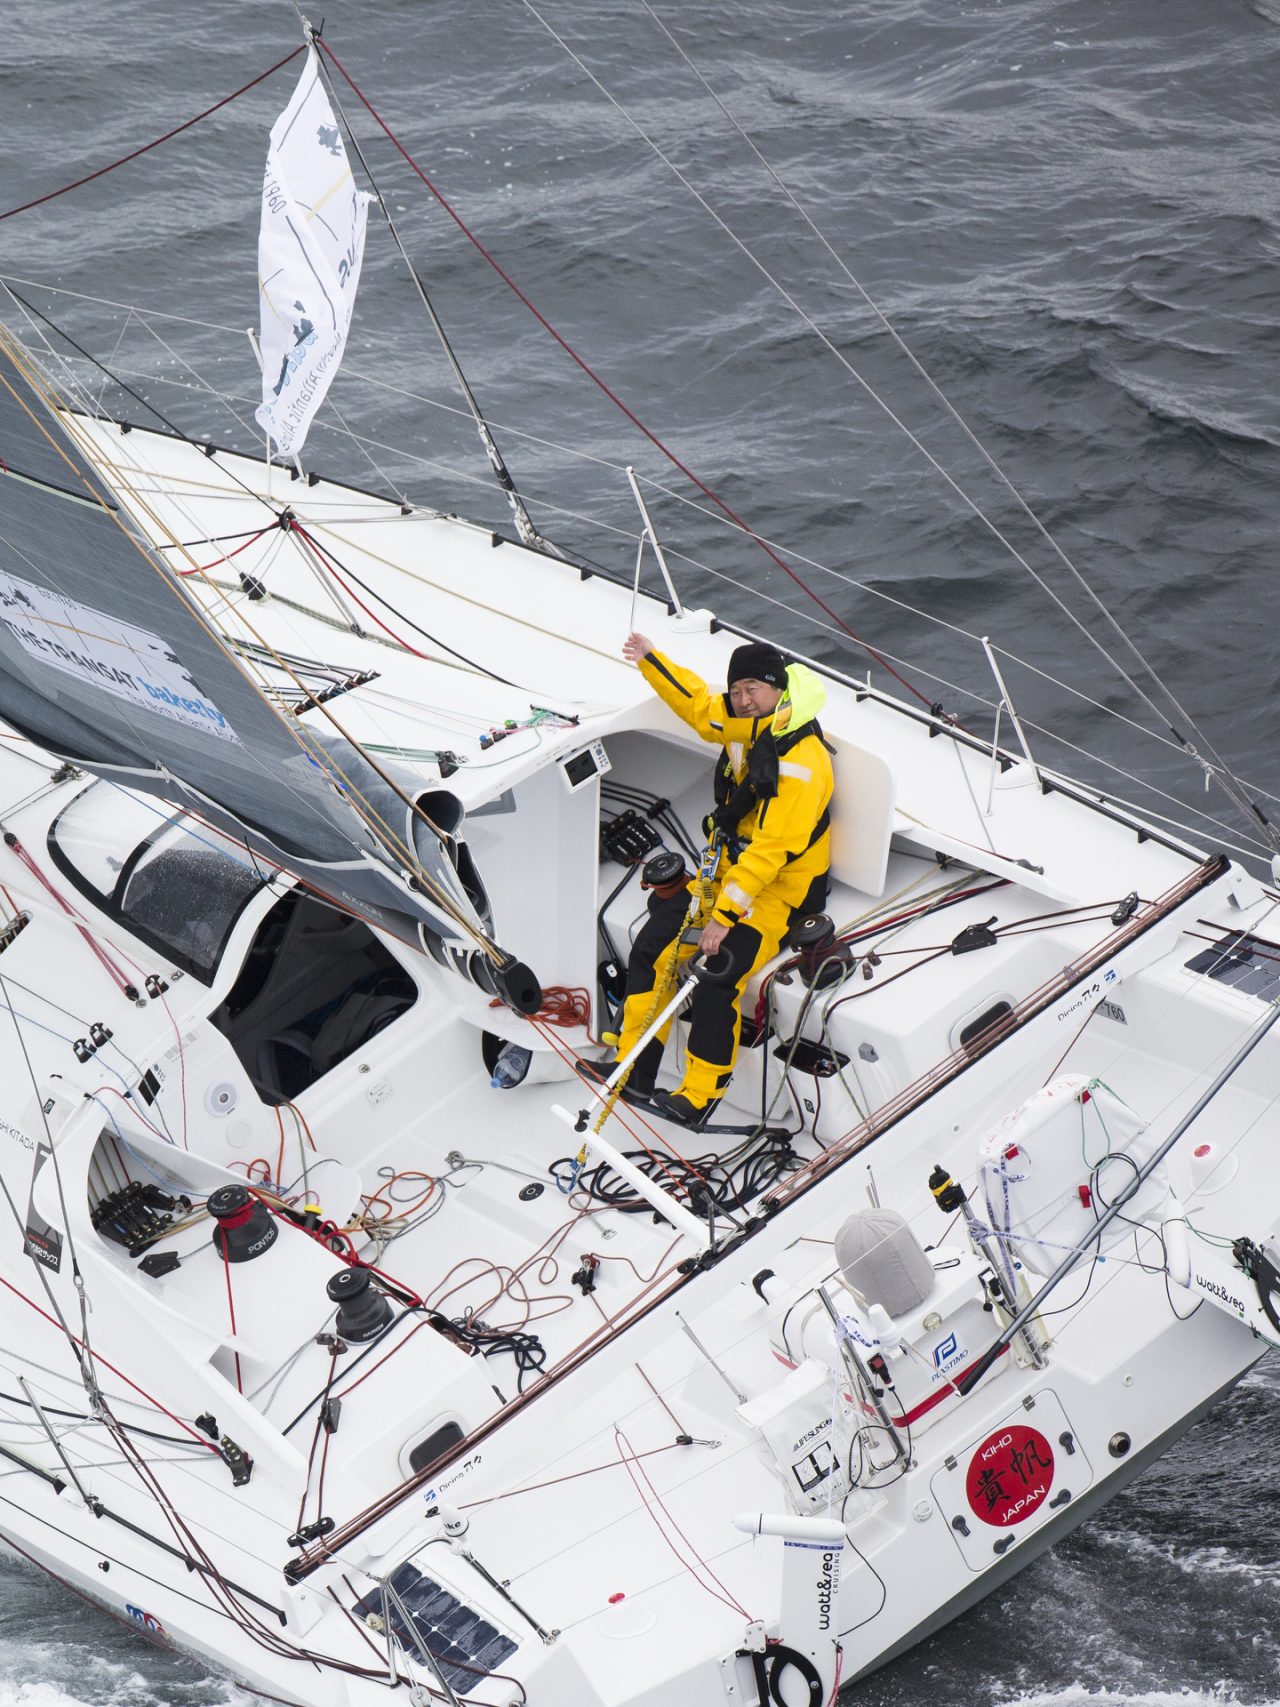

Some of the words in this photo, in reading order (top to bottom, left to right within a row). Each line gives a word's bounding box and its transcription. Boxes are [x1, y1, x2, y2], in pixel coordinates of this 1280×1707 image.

[2, 617, 49, 653] THE
[42, 638, 140, 692] TRANSAT
[136, 676, 226, 728] bakerly
[8, 1127, 36, 1153] KITADA
[247, 1227, 275, 1254] PONTOS
[1196, 1273, 1245, 1313] watt&sea
[931, 1349, 969, 1382] PLASTIMO
[981, 1433, 1013, 1462] KIHO
[975, 1439, 1052, 1513] 貴帆
[1001, 1484, 1047, 1523] JAPAN
[816, 1552, 833, 1631] watt&sea
[832, 1552, 841, 1594] CRUISING
